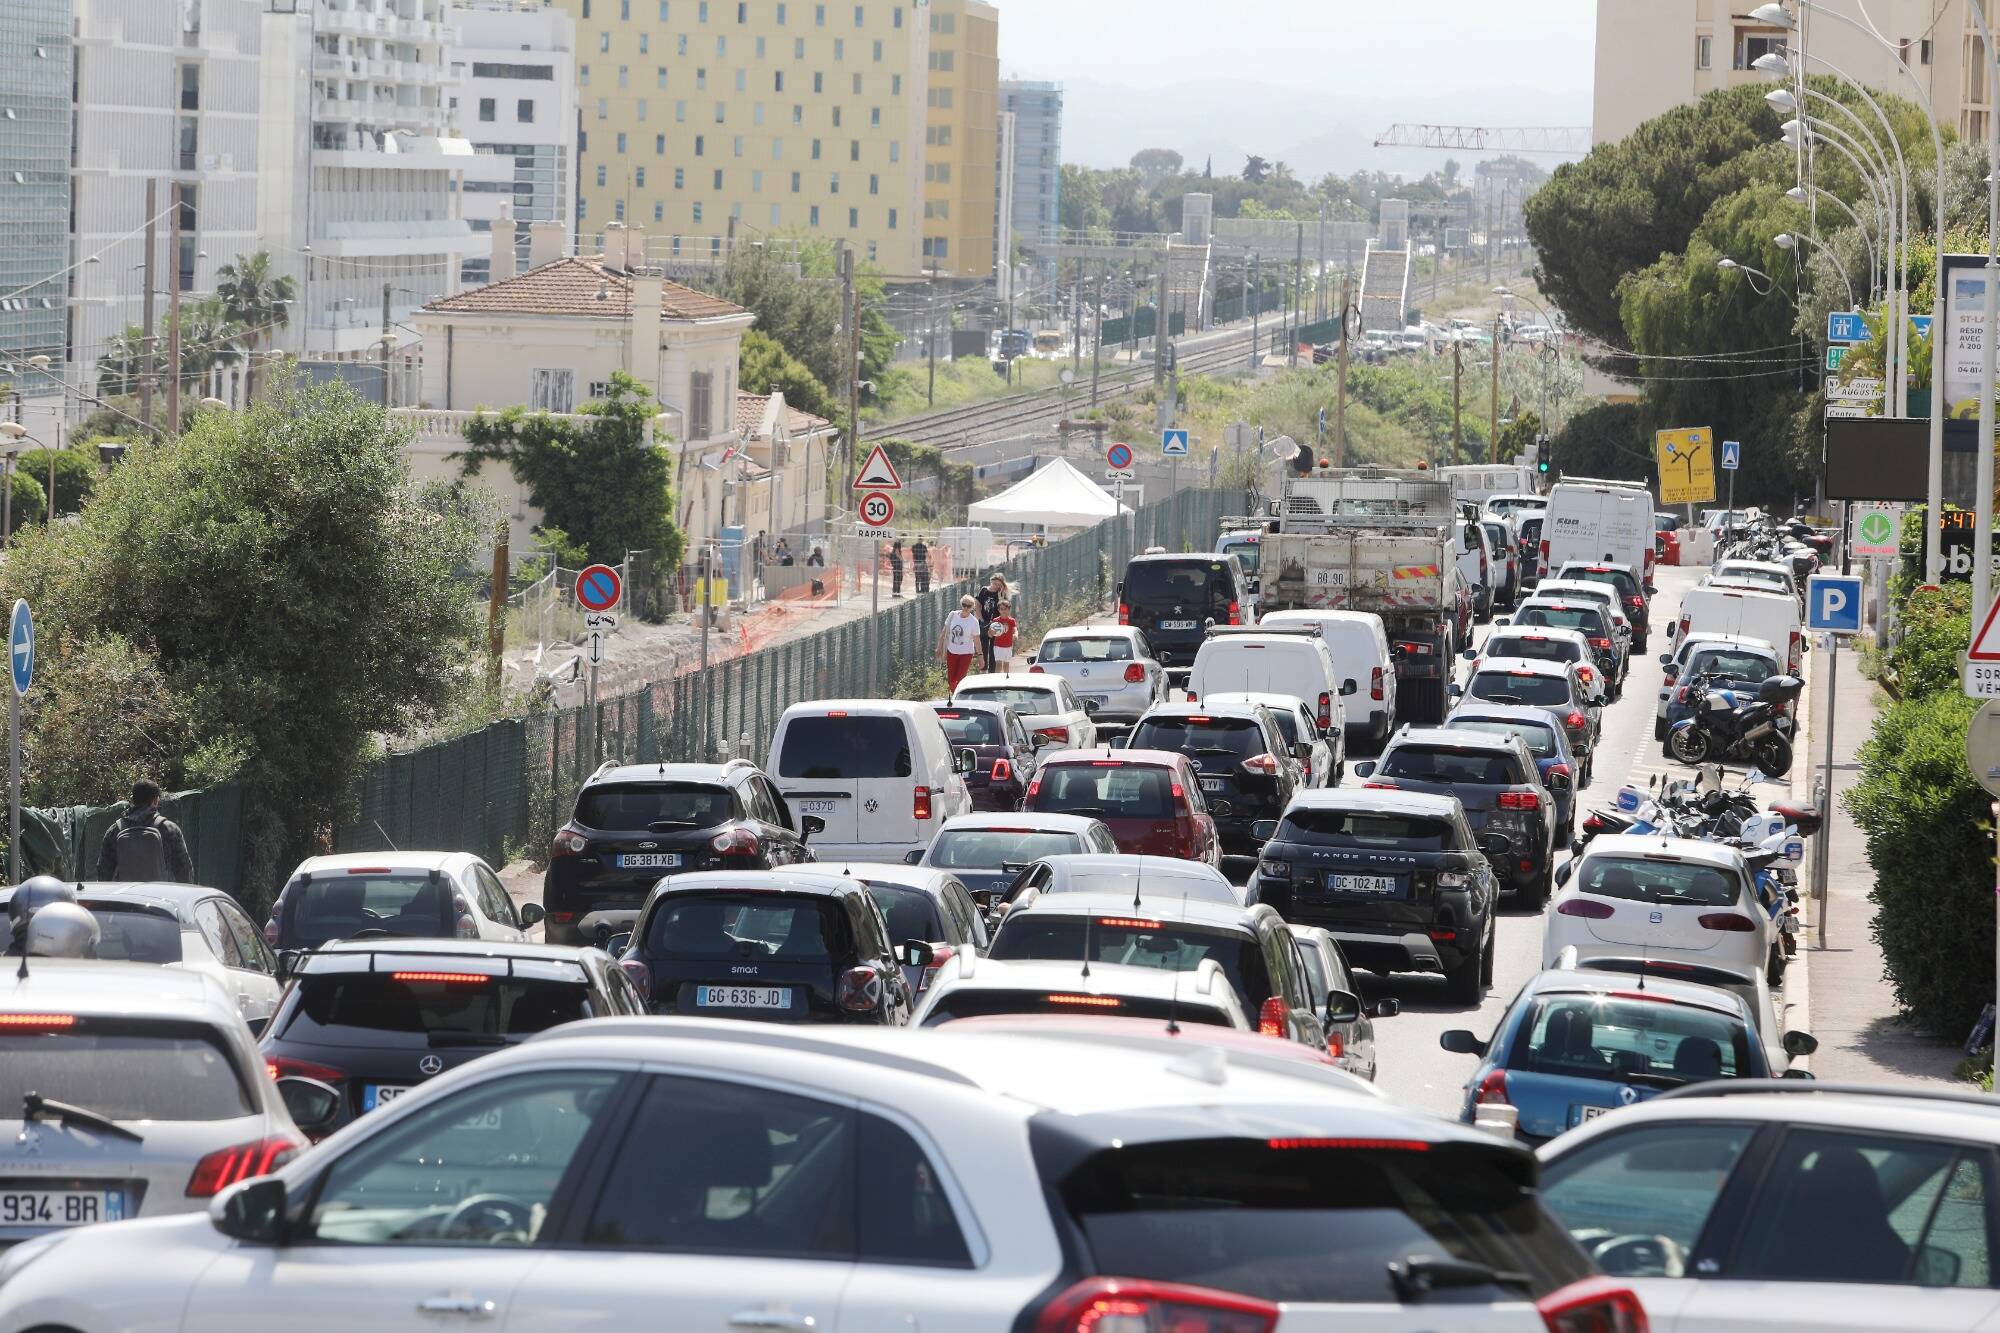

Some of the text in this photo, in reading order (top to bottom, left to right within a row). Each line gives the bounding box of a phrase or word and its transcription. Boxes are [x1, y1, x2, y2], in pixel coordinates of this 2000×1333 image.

[867, 502, 887, 517] 30
[858, 529, 893, 539] RAPPEL
[1823, 588, 1847, 621] P
[1369, 855, 1416, 863] ROVER
[1335, 876, 1387, 890] DC-102-AA
[731, 966, 758, 974] smart
[708, 988, 780, 1006] GG-636-JD
